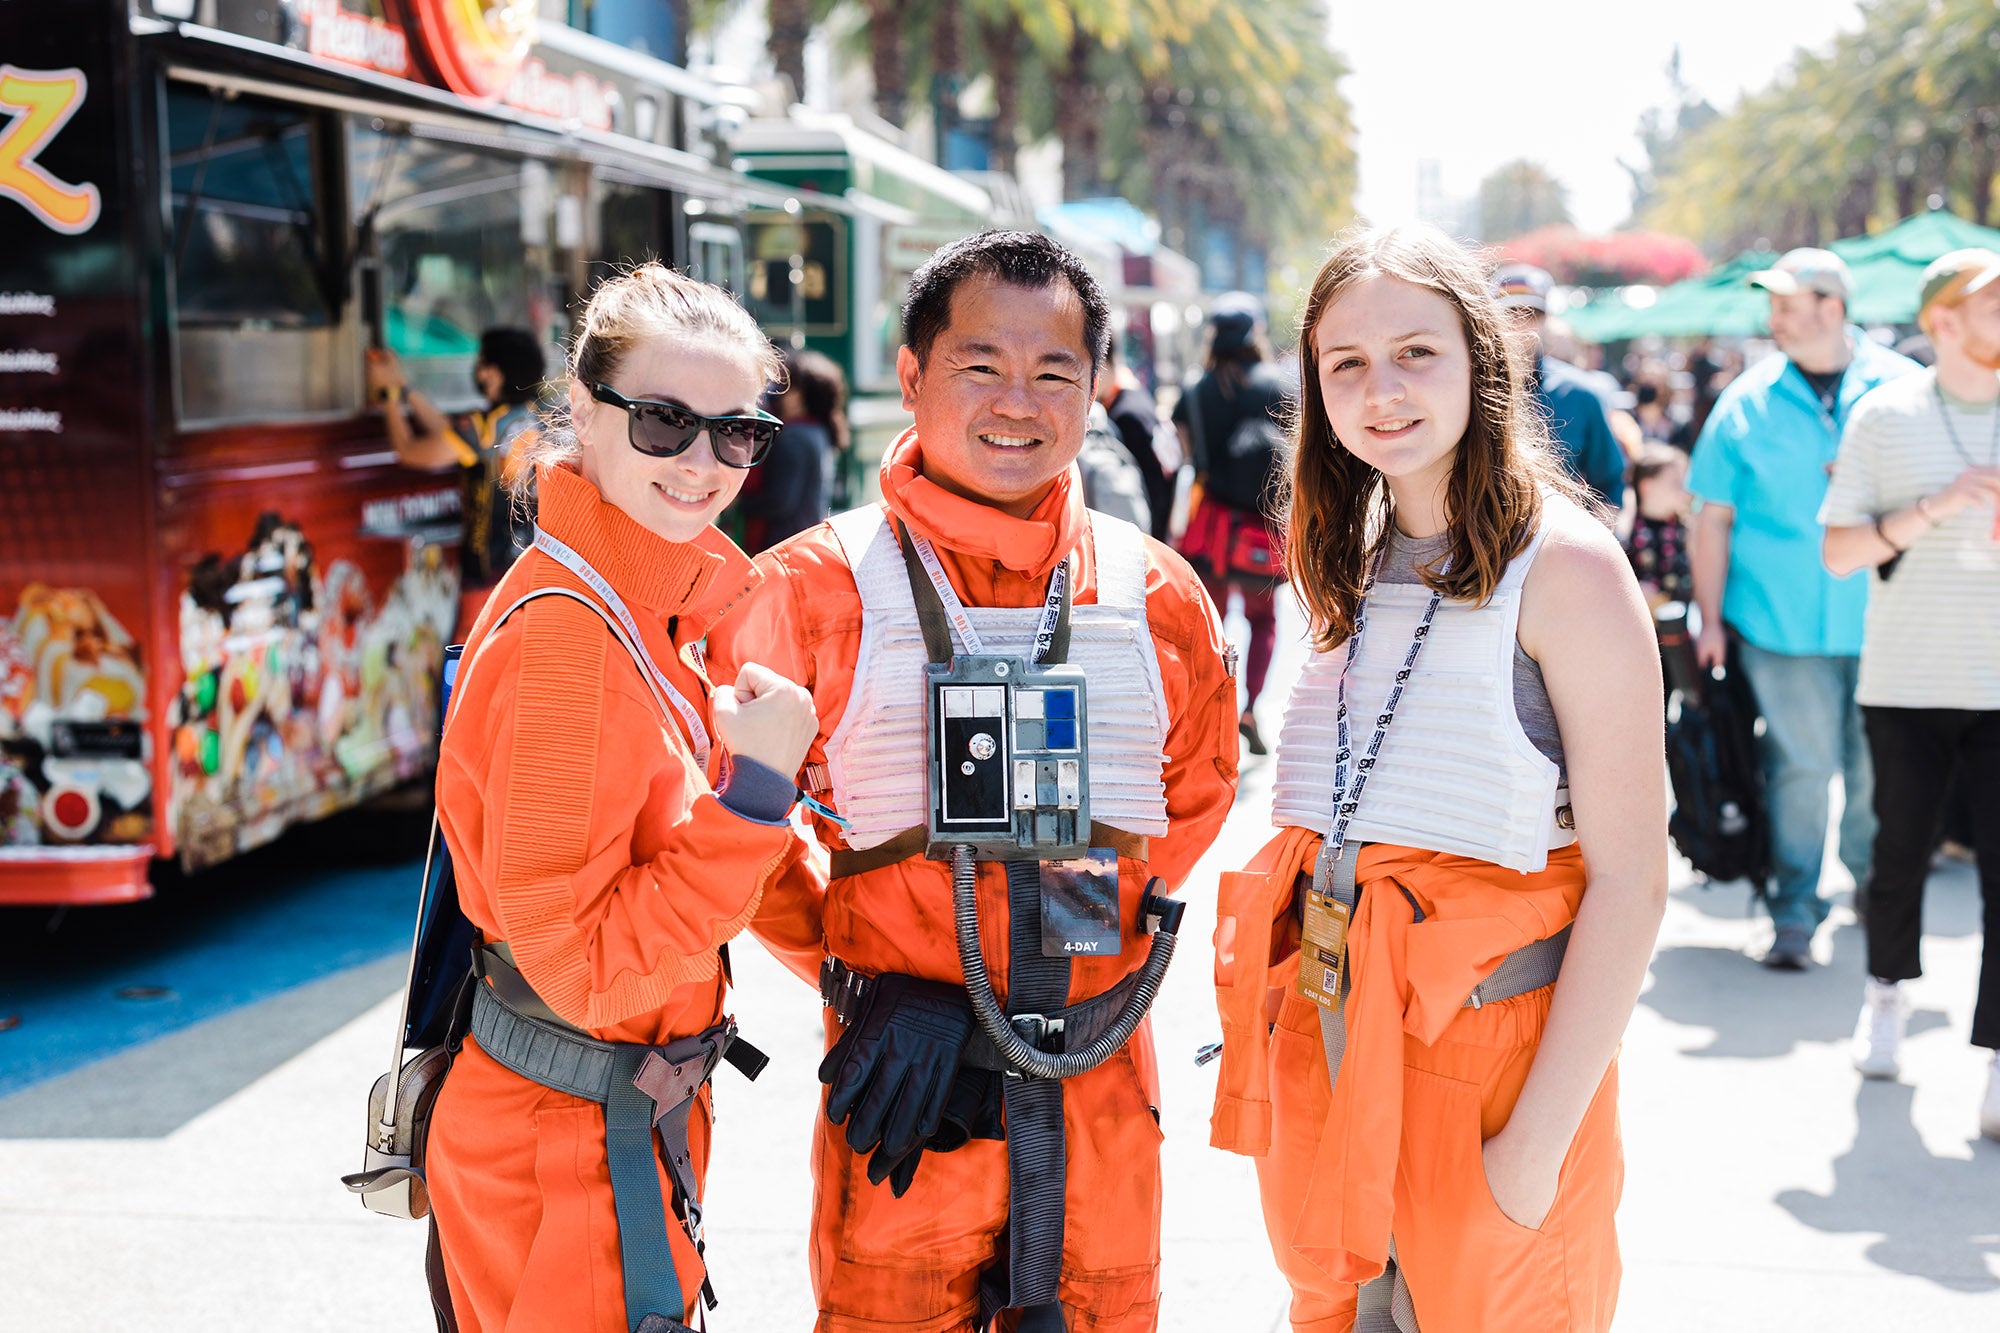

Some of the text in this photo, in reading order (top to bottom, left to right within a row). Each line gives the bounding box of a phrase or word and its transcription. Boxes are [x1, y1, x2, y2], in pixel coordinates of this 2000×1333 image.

[578, 565, 616, 603] BOXLUNCH
[931, 570, 955, 607] BOXLUNCH
[954, 614, 981, 655] BOXLUNCH
[1064, 941, 1099, 952] 4-DAY
